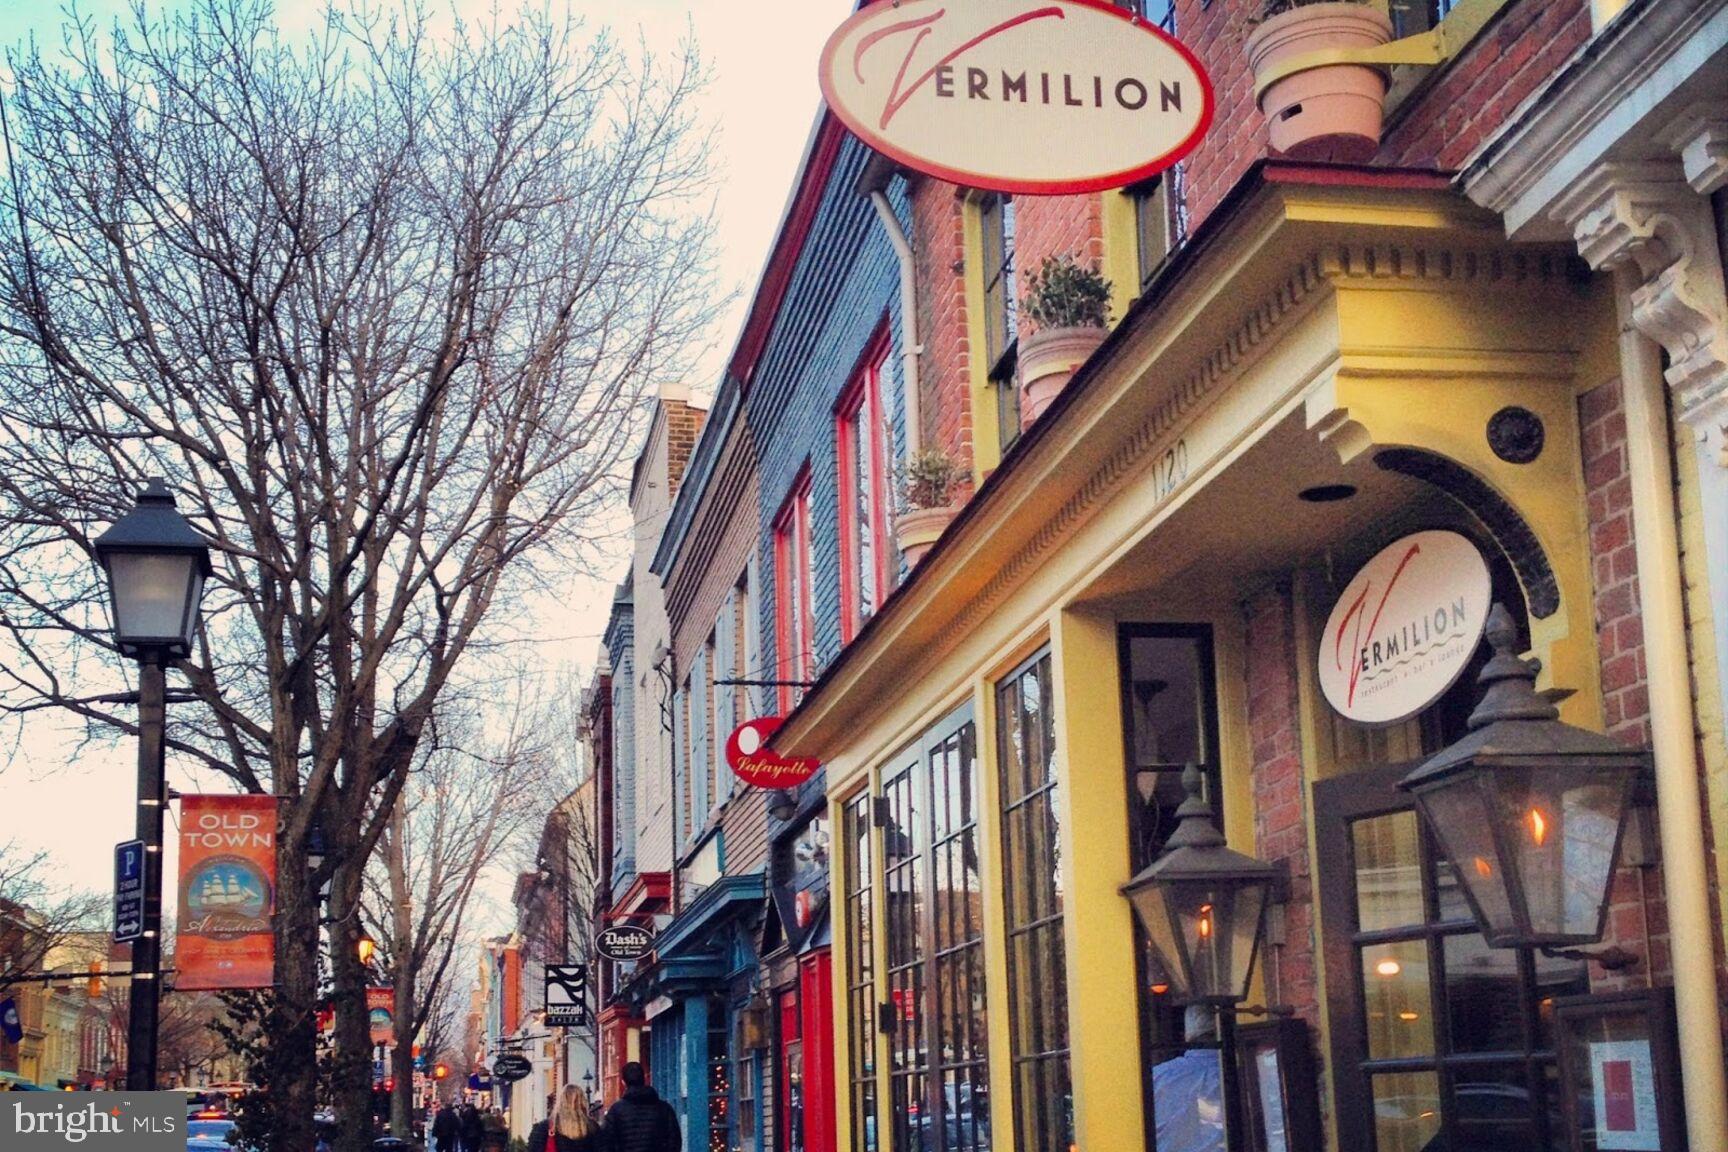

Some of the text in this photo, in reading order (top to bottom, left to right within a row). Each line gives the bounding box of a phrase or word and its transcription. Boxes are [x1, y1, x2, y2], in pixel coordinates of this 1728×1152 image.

[853, 6, 1183, 131] VERMILION
[1152, 439, 1188, 501] 1120
[1336, 543, 1467, 708] VERMILION
[199, 814, 260, 830] OLD
[184, 832, 272, 848] TOWN
[124, 851, 135, 876] P
[605, 932, 648, 946] Dash's
